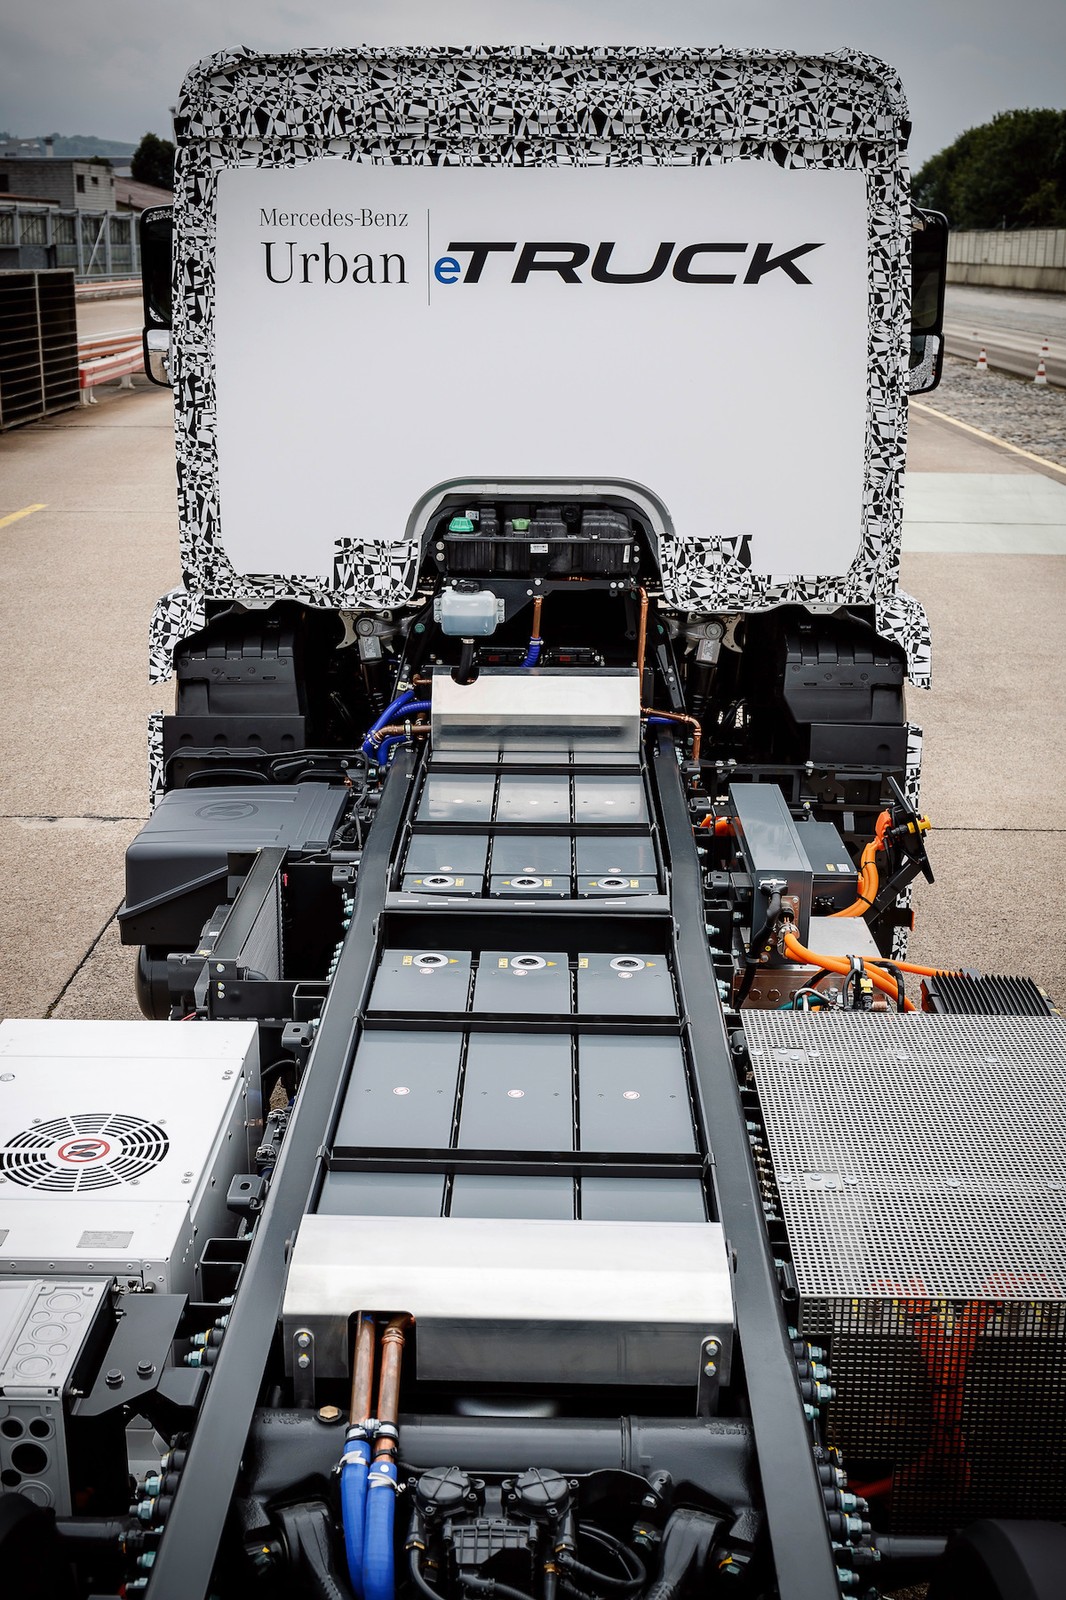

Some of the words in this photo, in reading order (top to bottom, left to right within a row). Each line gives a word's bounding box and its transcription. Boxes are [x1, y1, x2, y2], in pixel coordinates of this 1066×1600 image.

[259, 208, 409, 228] Mercedes-Benz
[261, 242, 409, 285] Urban
[434, 242, 826, 285] eTRUCK
